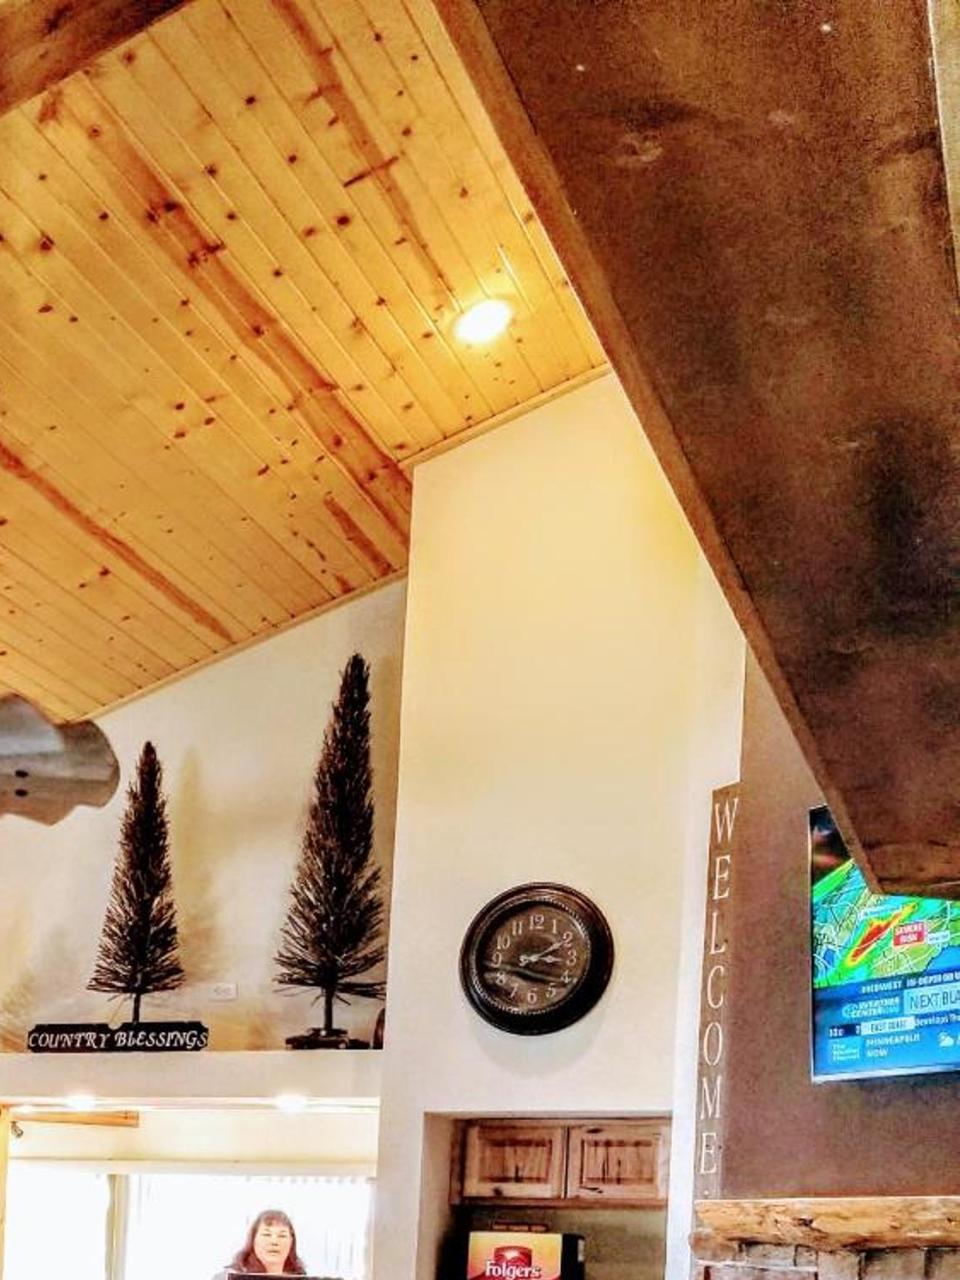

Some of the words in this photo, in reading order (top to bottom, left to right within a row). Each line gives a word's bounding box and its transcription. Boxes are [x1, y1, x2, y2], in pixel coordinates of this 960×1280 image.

[512, 920, 522, 936] 11
[529, 914, 544, 930] 12
[552, 919, 557, 934] 1
[497, 935, 510, 949] 10
[562, 931, 573, 947] 2
[492, 951, 502, 968] 9
[566, 949, 577, 966] 3
[495, 971, 505, 985] 8
[561, 969, 571, 984] 4
[510, 982, 519, 998] 7
[545, 982, 556, 998] 5
[700, 797, 739, 1175] WELCOME
[527, 987, 537, 1004] 6
[910, 992, 941, 1009] NEXT
[29, 1031, 111, 1049] COUNTRY
[114, 1030, 208, 1049] BLESSINGS
[485, 1260, 542, 1280] Folgers
